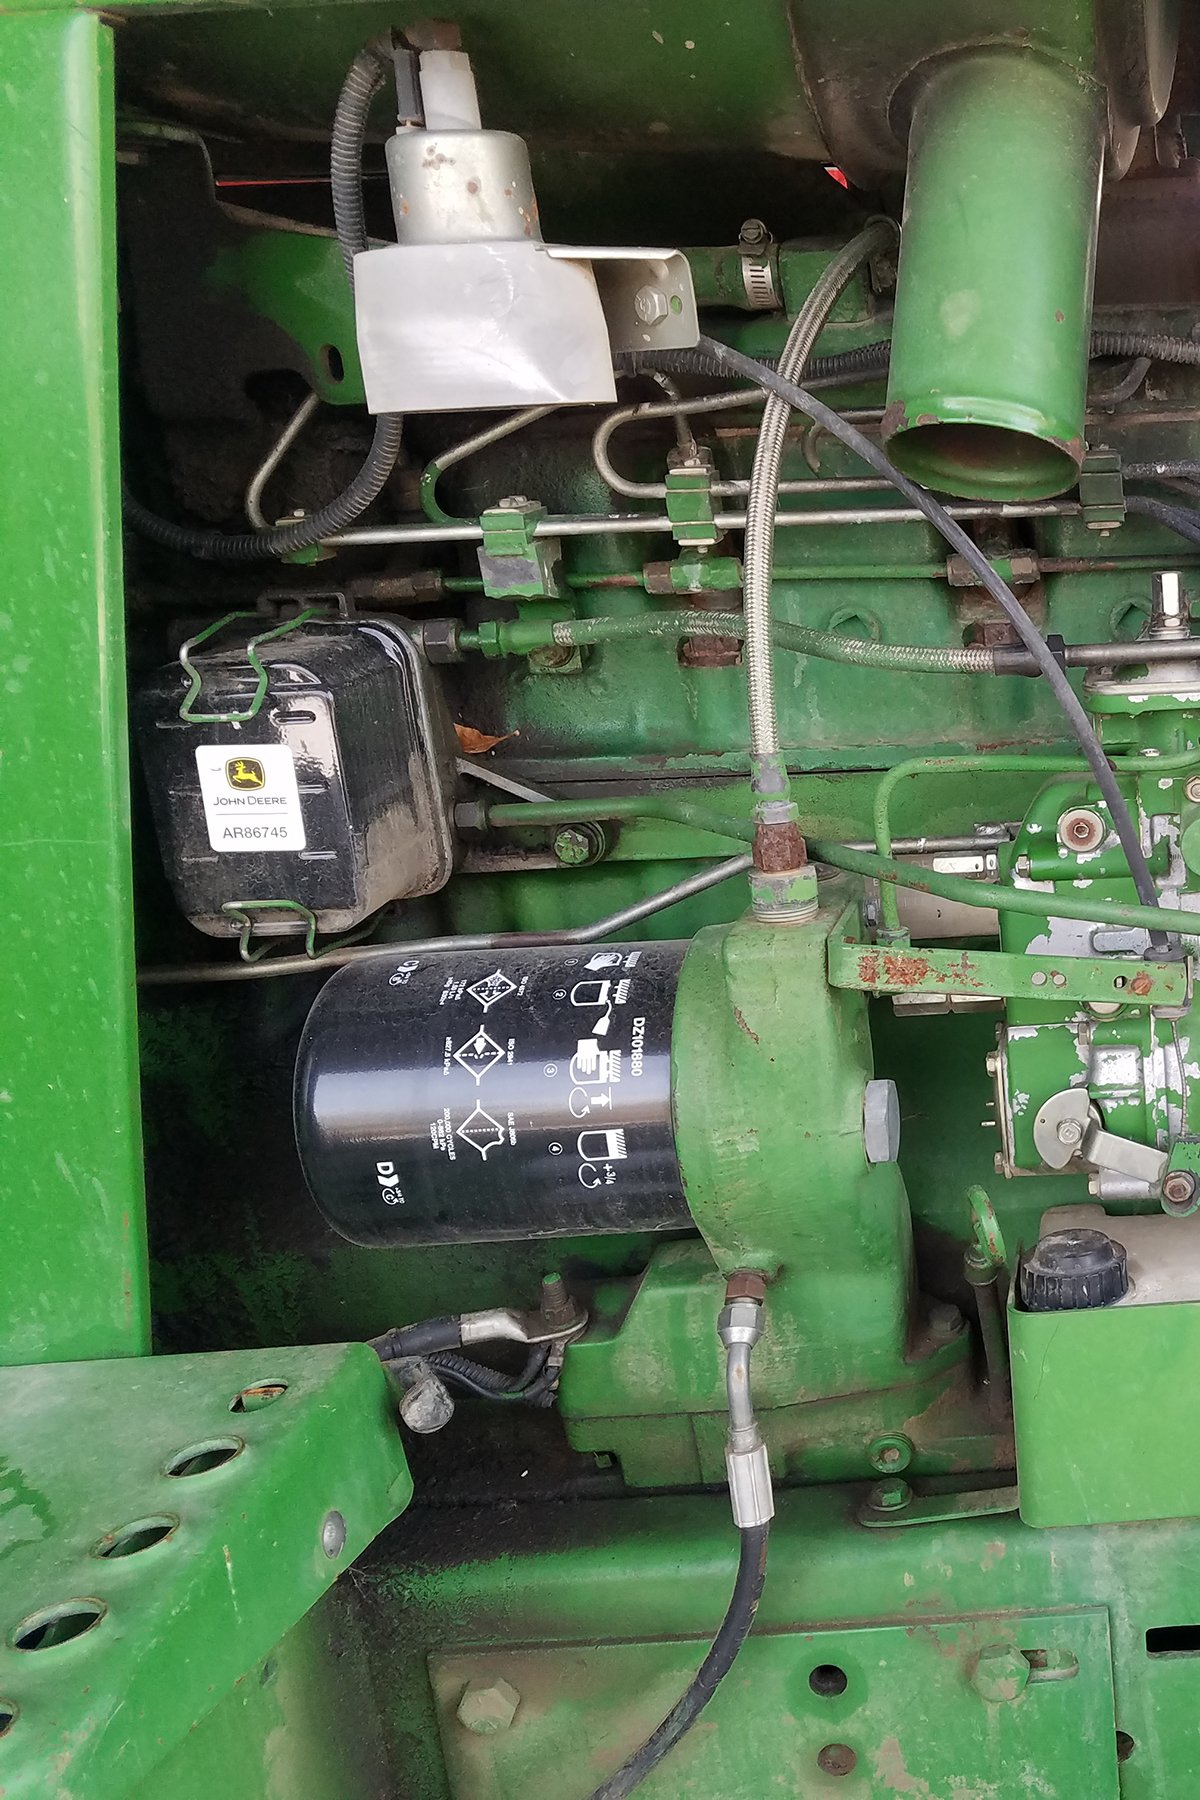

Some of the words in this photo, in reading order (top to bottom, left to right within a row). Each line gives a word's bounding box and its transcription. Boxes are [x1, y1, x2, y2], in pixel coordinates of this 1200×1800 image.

[213, 796, 246, 806] JOHN
[247, 795, 288, 805] DEERE
[223, 826, 288, 839] AR86745
[507, 1037, 516, 1051] ISO
[630, 1016, 645, 1076] DZ101880
[443, 1107, 452, 1133] 200,000
[429, 1122, 438, 1149] 120CPM
[445, 1134, 456, 1160] CYCLES
